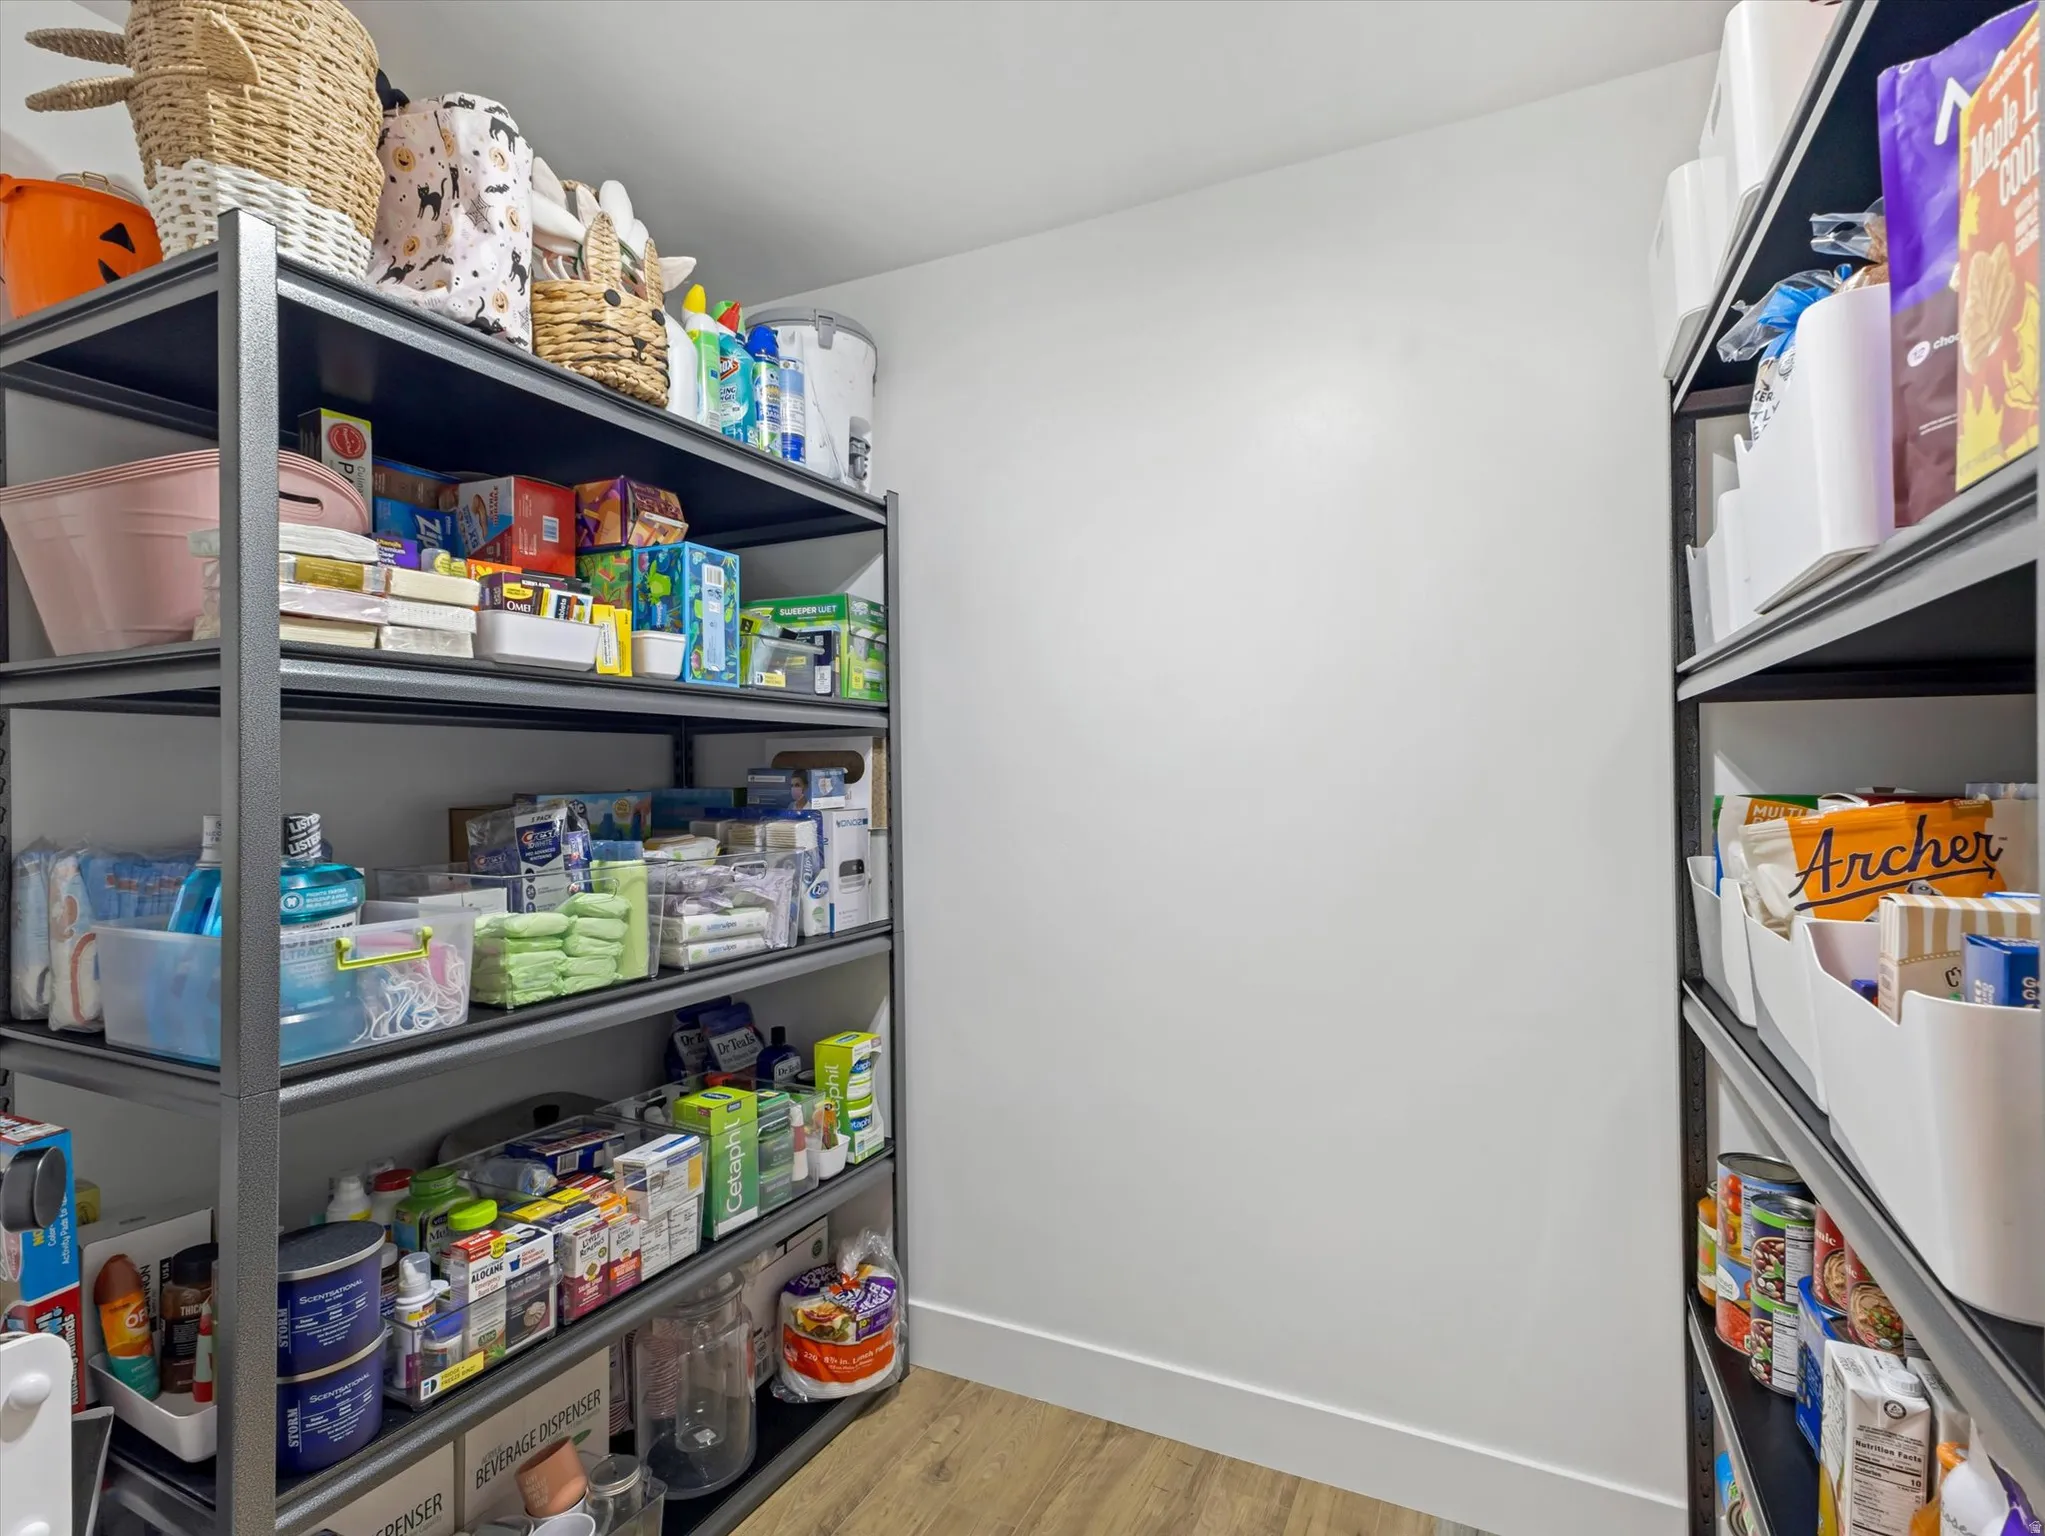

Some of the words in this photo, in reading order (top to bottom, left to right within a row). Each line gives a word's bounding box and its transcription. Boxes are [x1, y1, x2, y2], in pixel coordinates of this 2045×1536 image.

[1971, 93, 2018, 189] Maple
[416, 514, 443, 549] Zip
[779, 606, 817, 616] SWEEPER
[817, 605, 838, 614] WET
[521, 828, 558, 845] Crest
[1788, 814, 2005, 899] Archer
[681, 1034, 695, 1046] Dr
[717, 1042, 730, 1055] Dr
[726, 1117, 746, 1213] Cetaphil
[60, 1218, 70, 1236] Pads
[60, 1236, 72, 1265] Activity
[161, 1262, 171, 1280] USA
[470, 1261, 505, 1284] ALOCANE
[299, 1278, 364, 1305] SCENTSATIONAL
[475, 1275, 501, 1291] Emergency
[277, 1307, 289, 1348] STORM
[803, 1351, 818, 1361] 220
[852, 1350, 874, 1364] Lunch
[309, 1372, 371, 1404] SCENTSATIONAL
[539, 1388, 601, 1443] DISPENSER
[286, 1407, 299, 1448] STORM
[475, 1428, 537, 1490] BEVERAGE
[1855, 1439, 1895, 1456] Nutrition
[1898, 1451, 1922, 1463] Facts
[1854, 1465, 1882, 1477] Calories
[1911, 1479, 1922, 1488] 10
